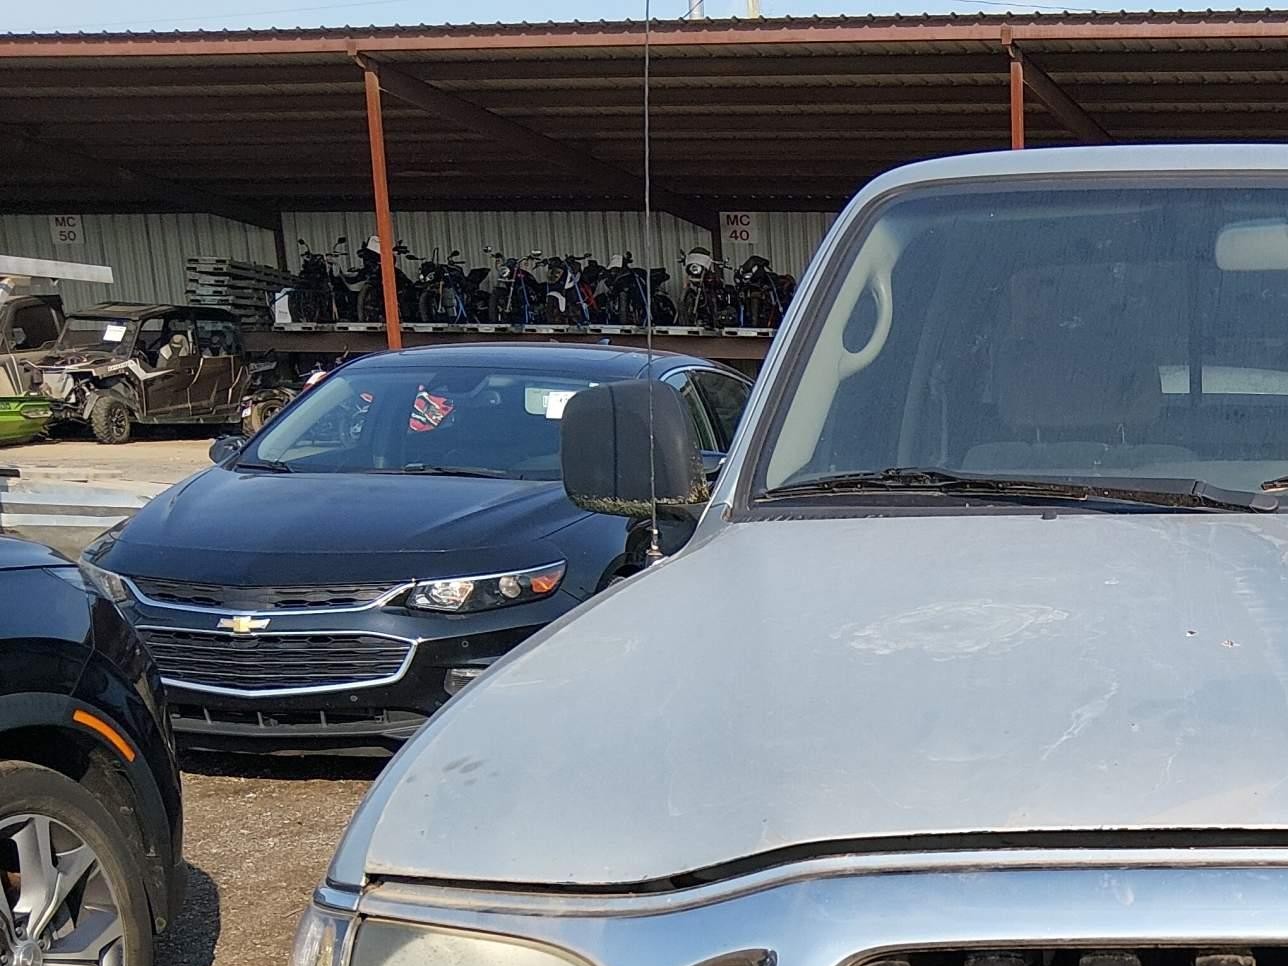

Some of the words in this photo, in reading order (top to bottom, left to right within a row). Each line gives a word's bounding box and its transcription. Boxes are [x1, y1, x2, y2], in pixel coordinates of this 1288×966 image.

[55, 216, 76, 227] MC
[726, 214, 751, 226] MC
[59, 230, 77, 242] 50
[729, 229, 750, 241] 40
